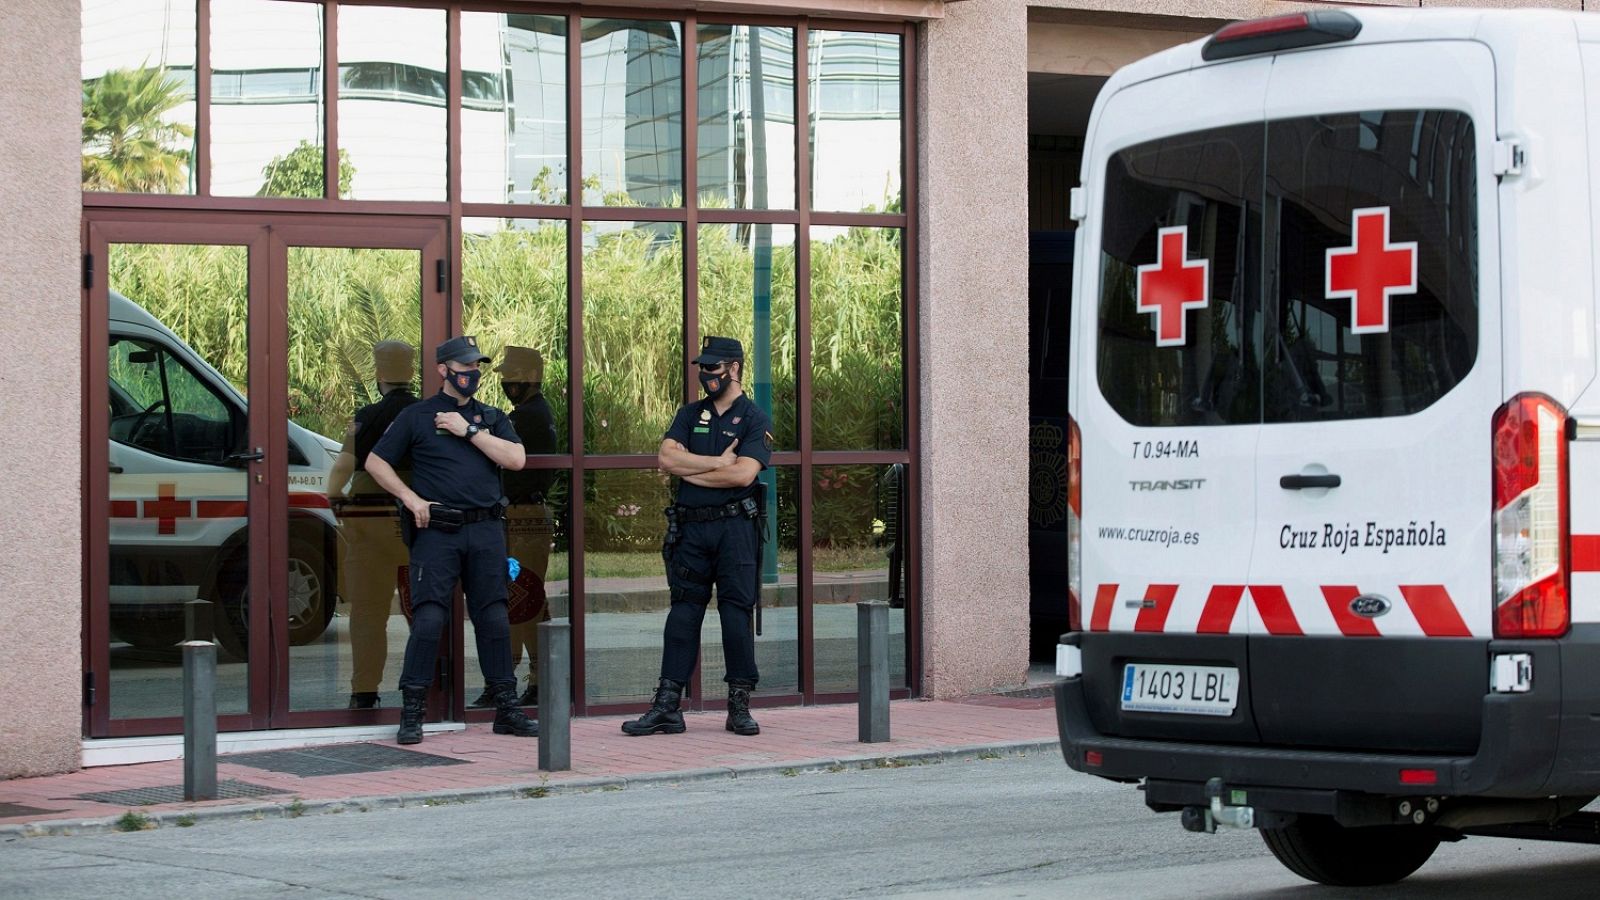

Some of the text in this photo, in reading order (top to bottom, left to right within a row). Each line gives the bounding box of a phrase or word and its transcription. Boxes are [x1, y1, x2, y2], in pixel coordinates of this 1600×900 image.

[1133, 440, 1199, 459] T 0.94-MA
[1129, 478, 1207, 491] TRANSIT
[1098, 526, 1200, 548] www.cruzroja.es
[1280, 520, 1447, 554] Cruz Roja Española
[1138, 670, 1230, 702] 1403 LBL
